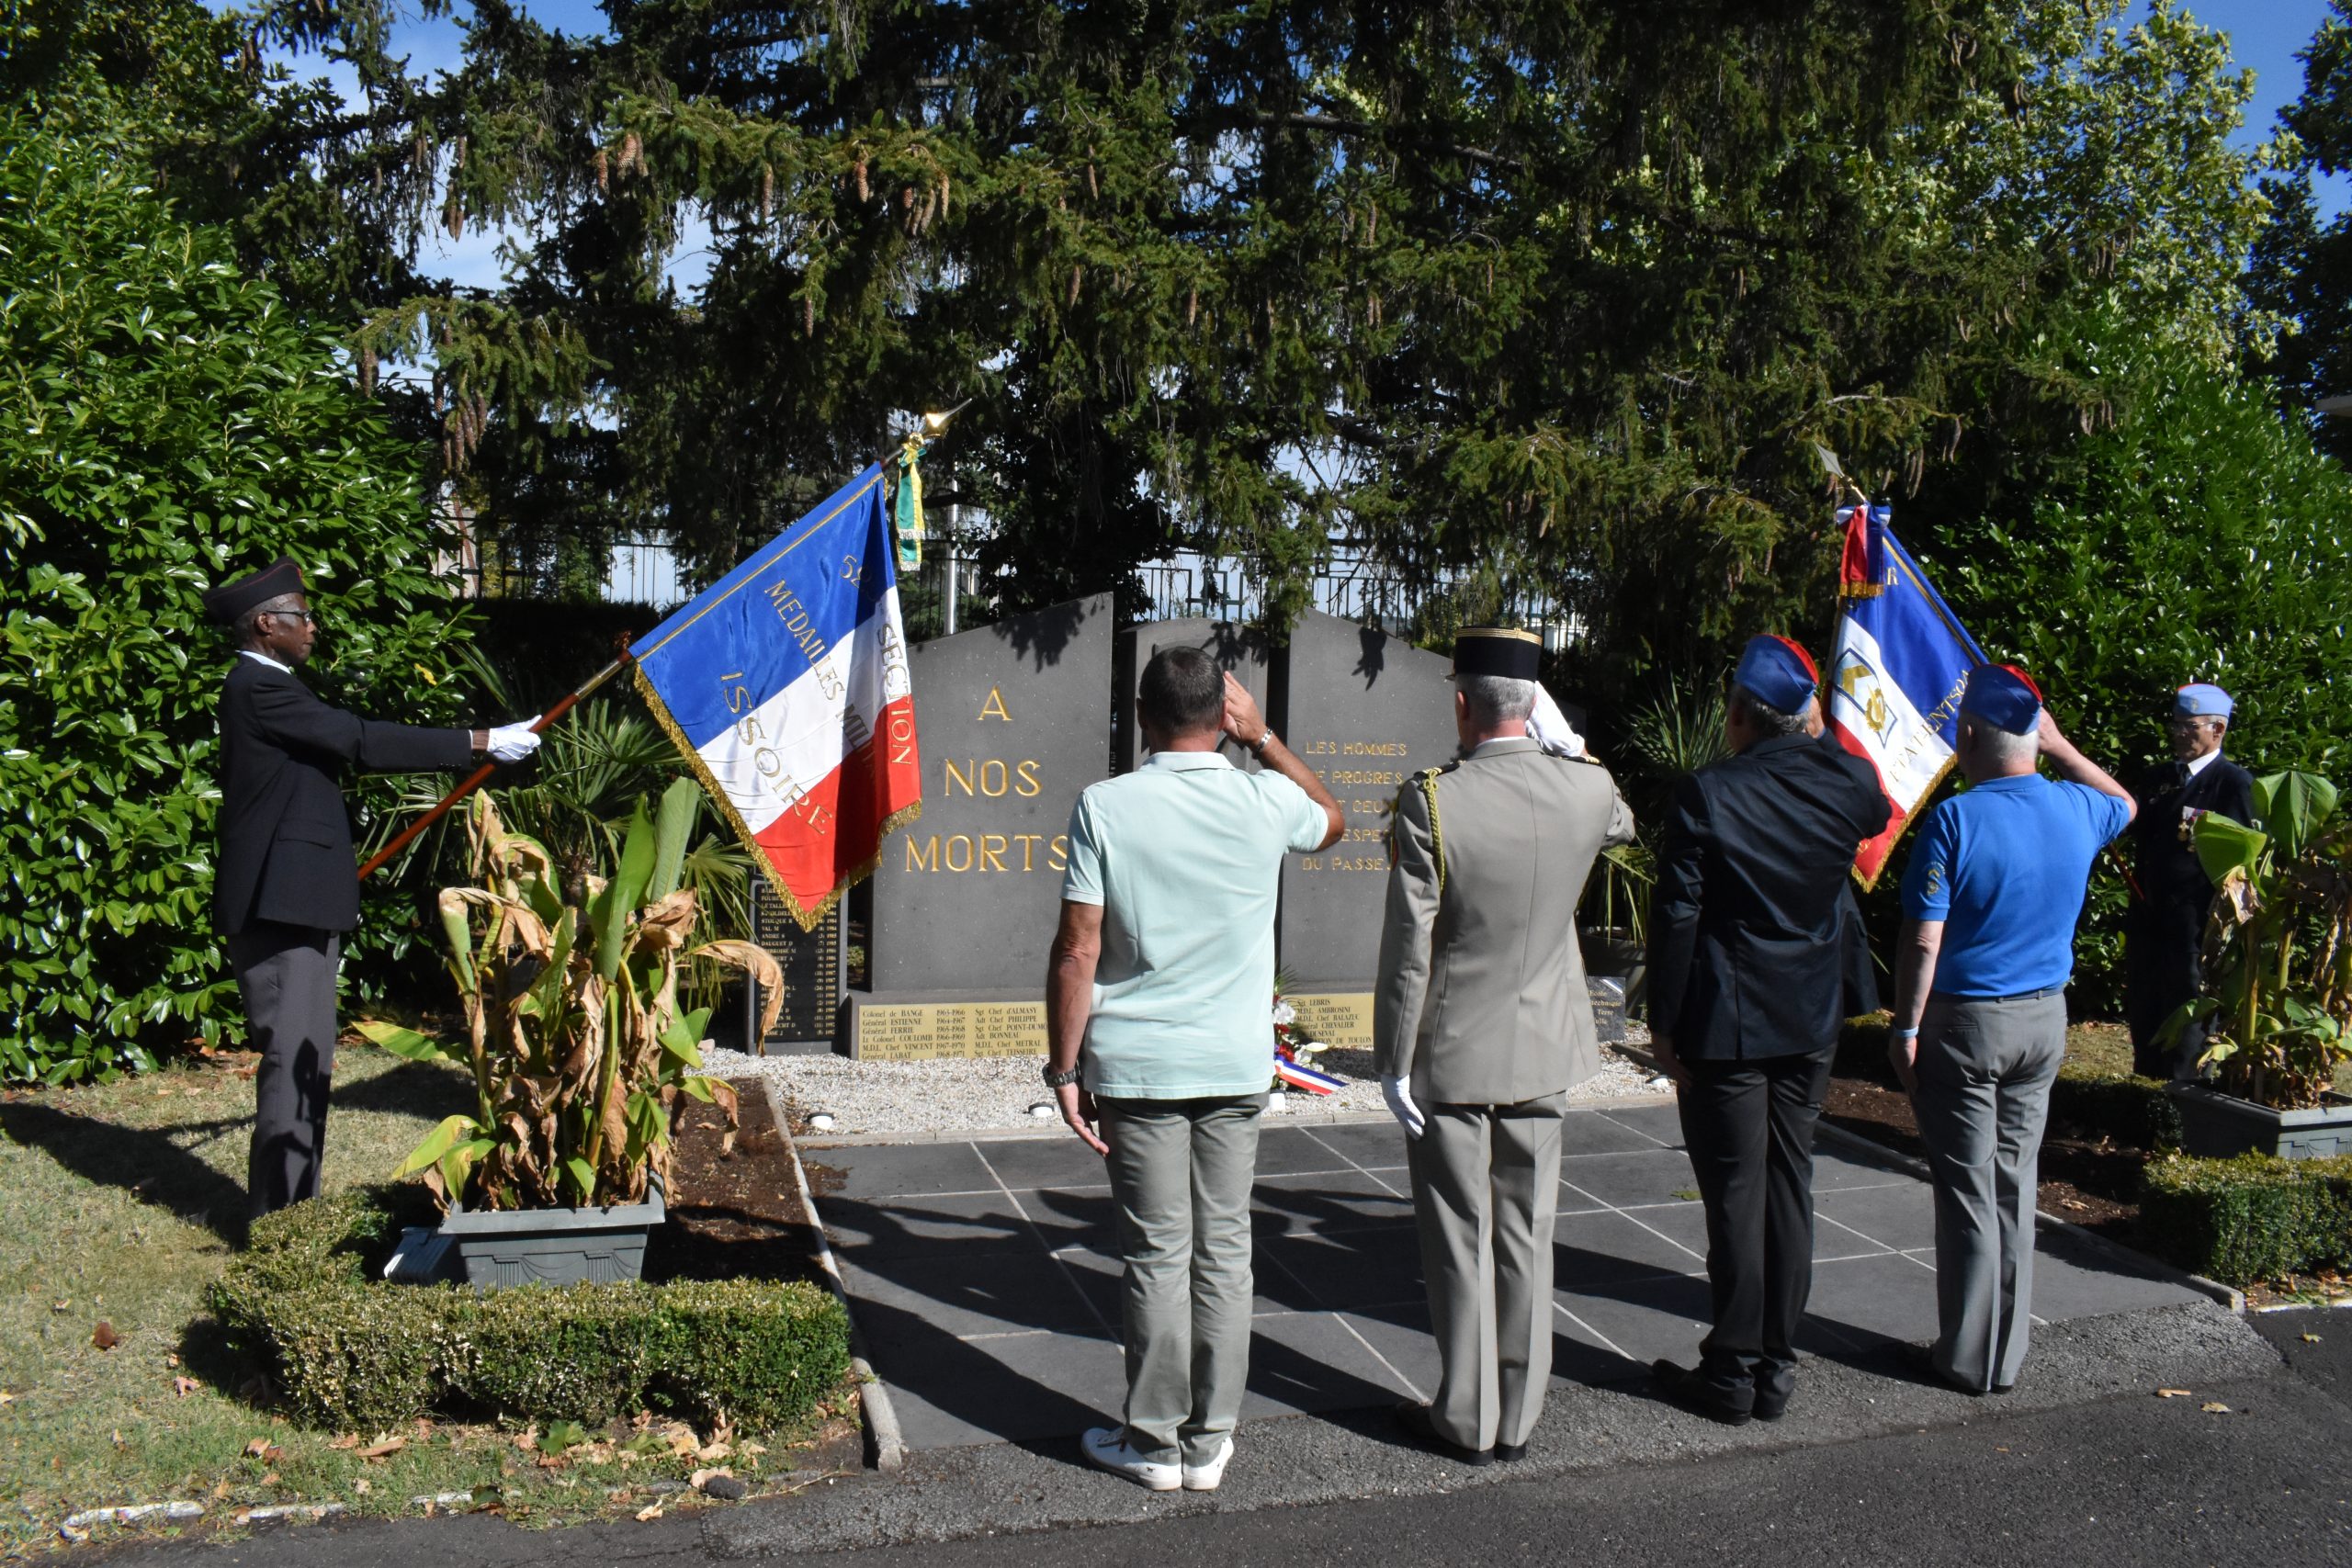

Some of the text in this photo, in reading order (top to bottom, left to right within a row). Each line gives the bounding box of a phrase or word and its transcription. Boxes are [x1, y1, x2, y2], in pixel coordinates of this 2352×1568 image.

[763, 579, 845, 701] MEDAILLES
[877, 623, 911, 764] SECTION
[977, 685, 1012, 721] A
[720, 671, 832, 835] ISSOIRE
[1306, 741, 1407, 756] LES HOMMES
[944, 758, 1042, 797] NOS
[1315, 771, 1403, 784] E PROGRES
[1352, 799, 1383, 813] CEU
[1341, 829, 1387, 841] ESPE
[905, 834, 1068, 872] MORTS
[1303, 857, 1323, 871] DU
[975, 1008, 984, 1016] Sgt
[890, 1018, 921, 1026] ESTIENNE
[863, 1027, 887, 1035] Général
[862, 1052, 886, 1060] Général
[890, 1051, 911, 1059] LABAT
